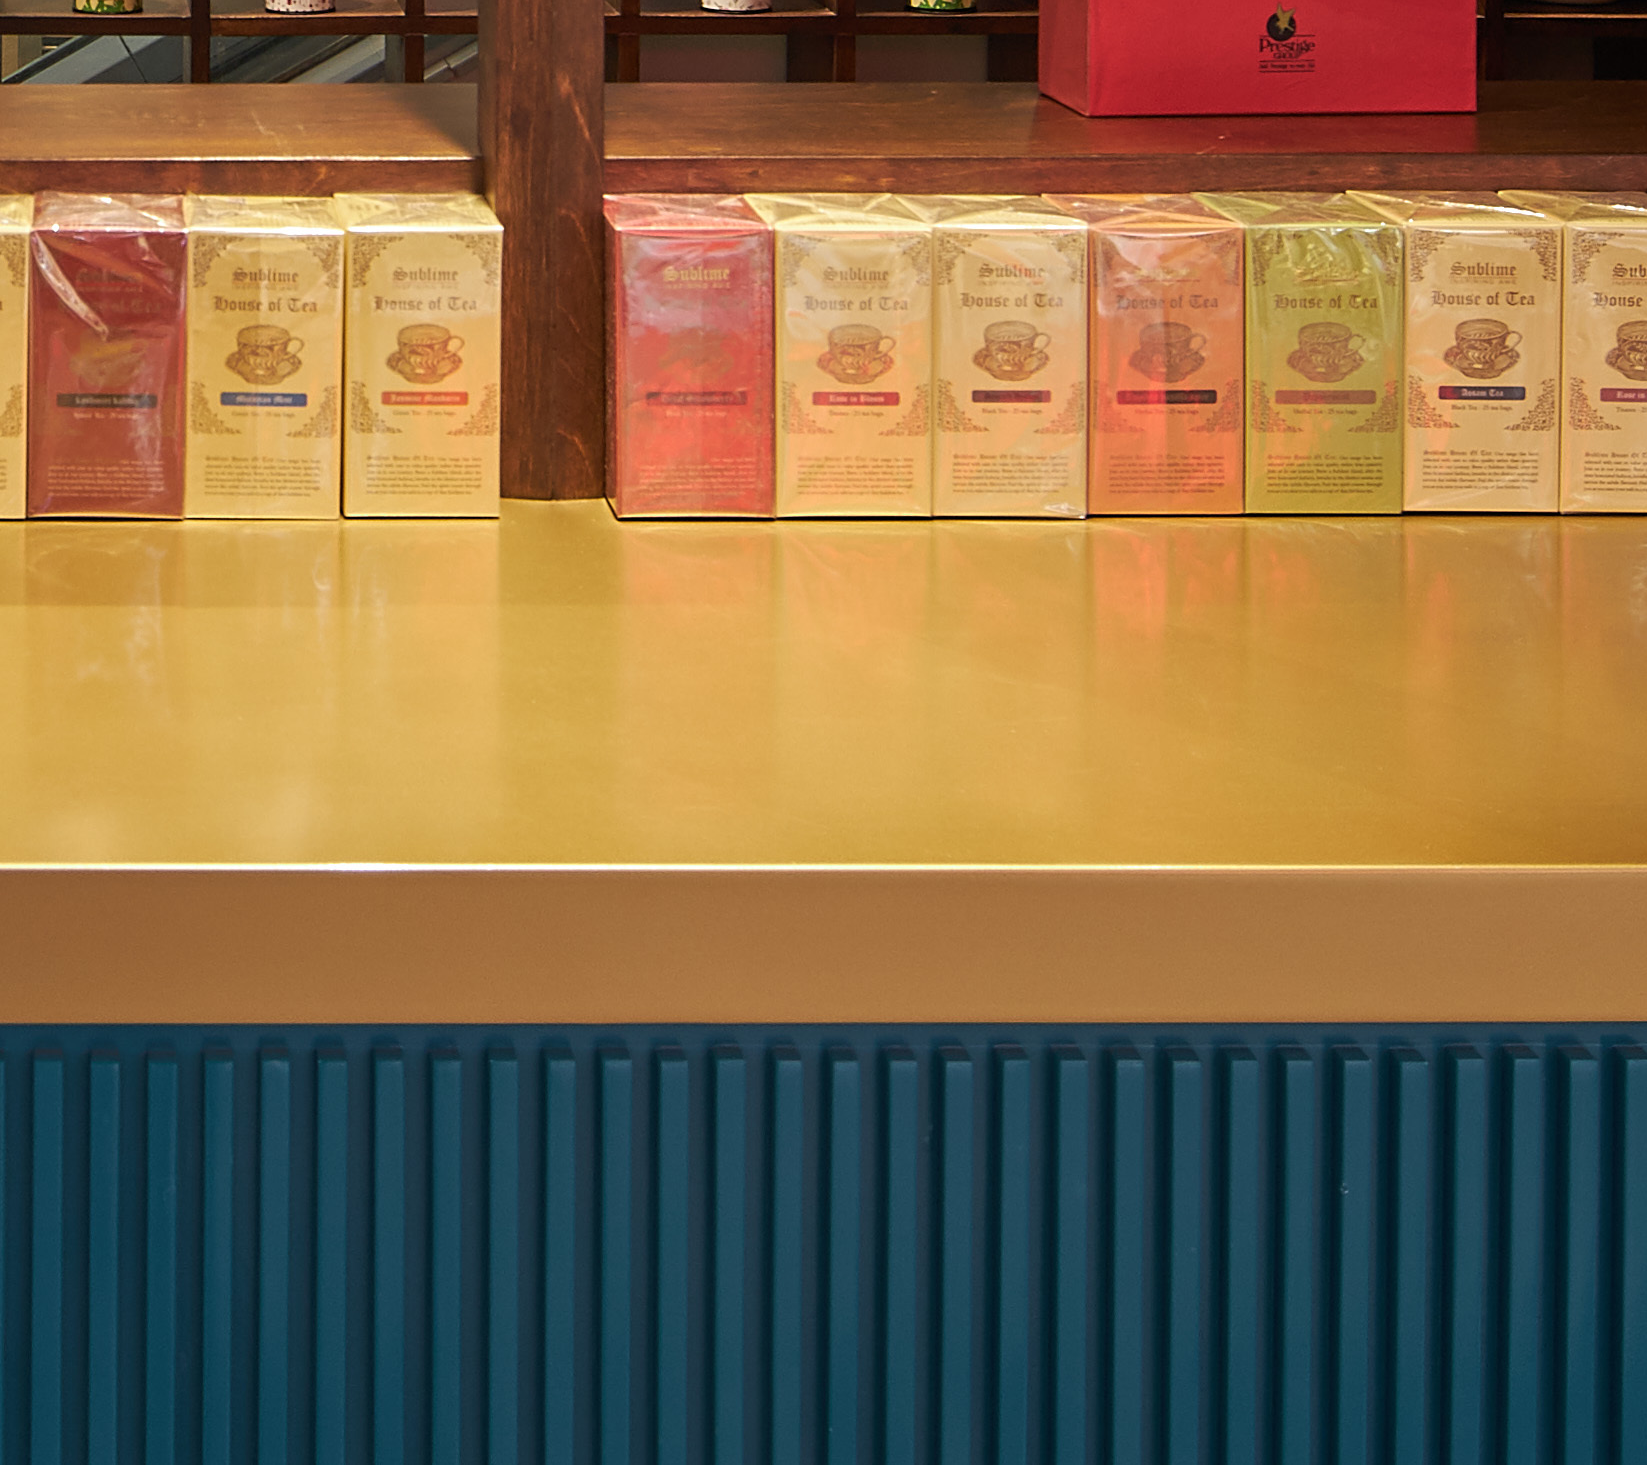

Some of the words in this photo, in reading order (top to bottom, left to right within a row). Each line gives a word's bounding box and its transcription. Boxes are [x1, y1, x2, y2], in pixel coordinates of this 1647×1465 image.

[1259, 38, 1316, 53] Prestige
[231, 267, 299, 283] Sublime
[391, 266, 459, 281] Sublime
[822, 265, 890, 281] Sublime
[1449, 261, 1517, 277] Sublime
[213, 296, 262, 313] House
[268, 297, 282, 311] of
[288, 297, 318, 311] Tea
[373, 295, 422, 311] House
[428, 296, 442, 311] of
[448, 296, 478, 311] Tea
[804, 295, 853, 311] House
[859, 295, 873, 310] of
[878, 295, 909, 310] Tea
[959, 291, 1008, 307] House
[1014, 292, 1028, 307] of
[1034, 292, 1064, 307] Tea
[1431, 290, 1480, 307] House
[1486, 291, 1500, 305] of
[1506, 291, 1536, 305] Tea
[1593, 291, 1642, 308] House
